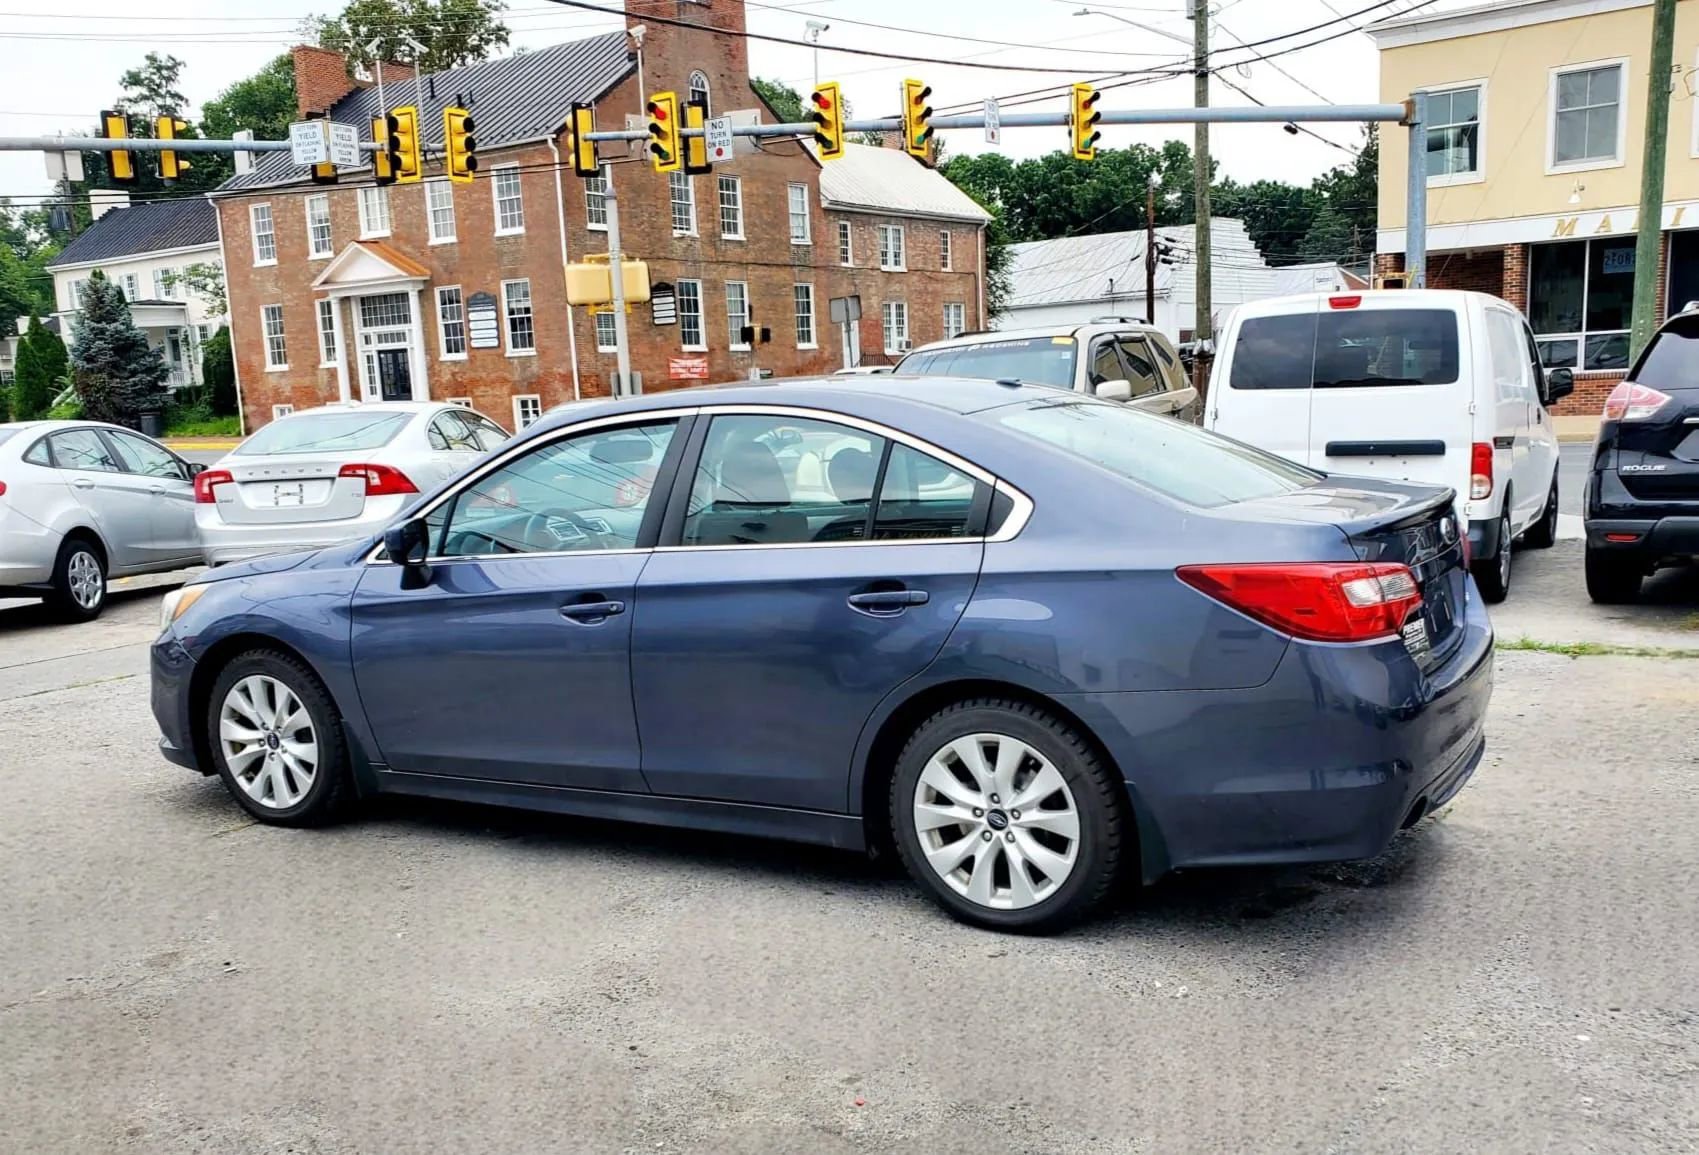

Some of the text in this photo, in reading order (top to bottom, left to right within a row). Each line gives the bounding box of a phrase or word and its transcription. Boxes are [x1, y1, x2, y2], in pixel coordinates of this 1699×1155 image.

[711, 121, 724, 130] NO
[298, 131, 317, 140] YIELD
[335, 133, 352, 141] YIELD
[711, 131, 727, 139] TURN
[718, 139, 730, 147] RED
[1622, 464, 1666, 472] ROGUE
